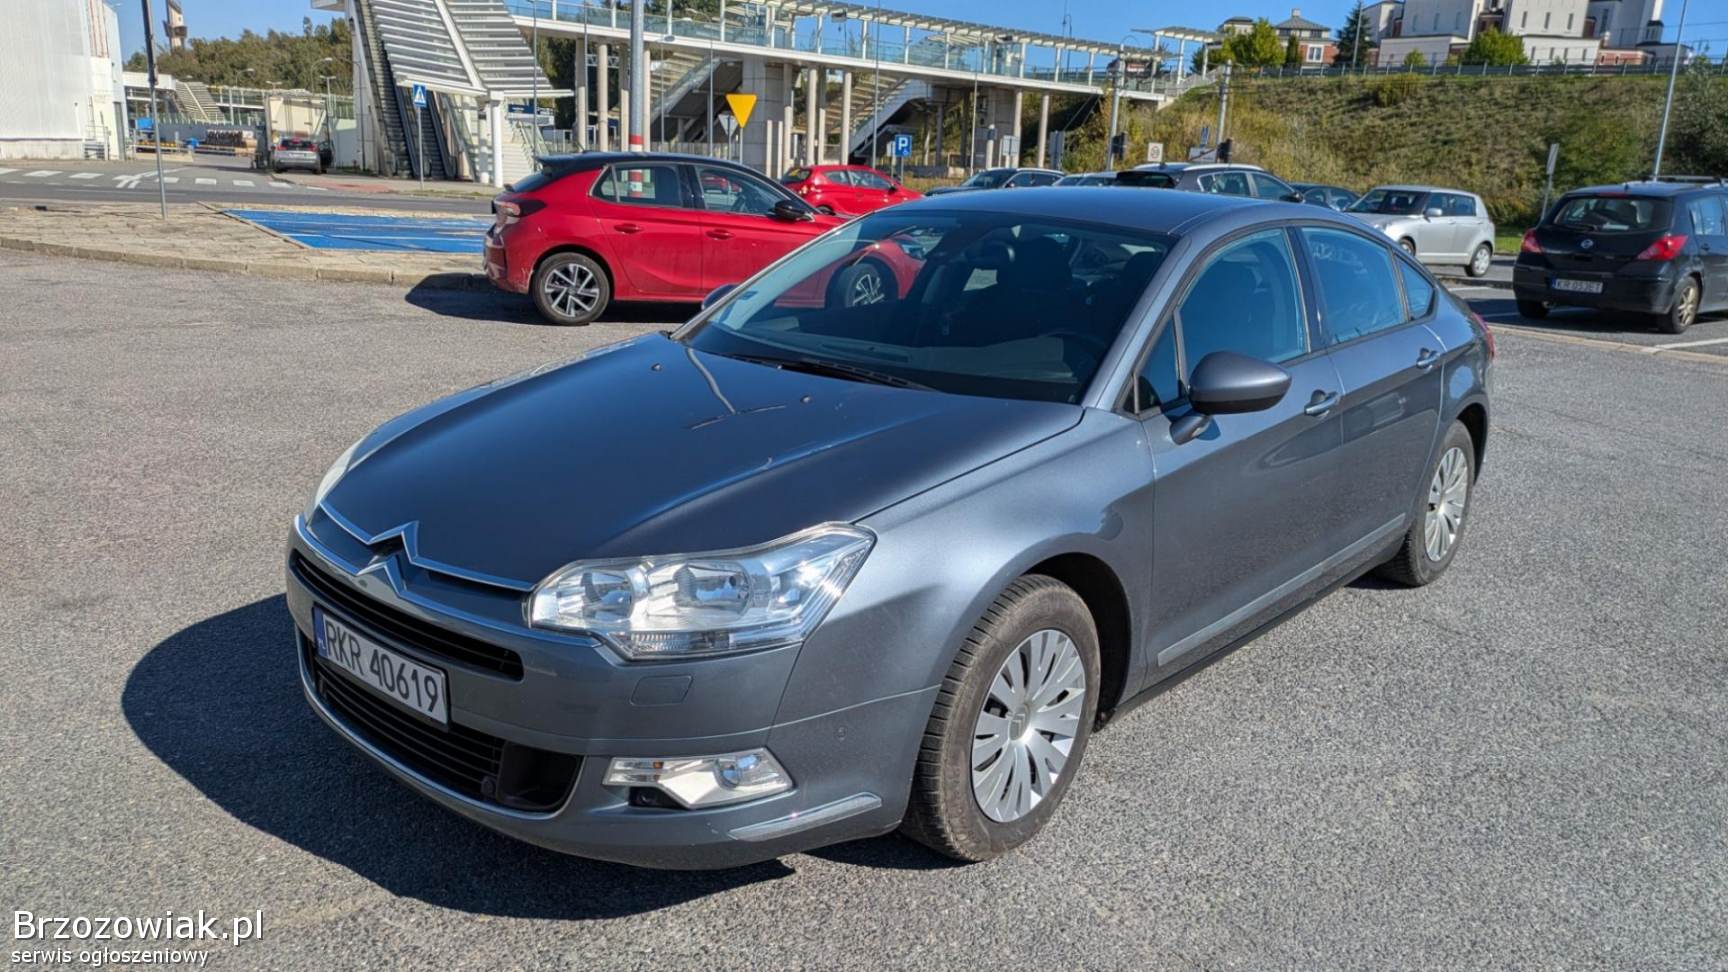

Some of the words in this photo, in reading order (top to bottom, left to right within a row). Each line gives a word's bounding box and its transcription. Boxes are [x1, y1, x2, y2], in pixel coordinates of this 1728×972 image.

[898, 137, 908, 151] P
[325, 619, 365, 676] RKR
[369, 649, 439, 713] 40619
